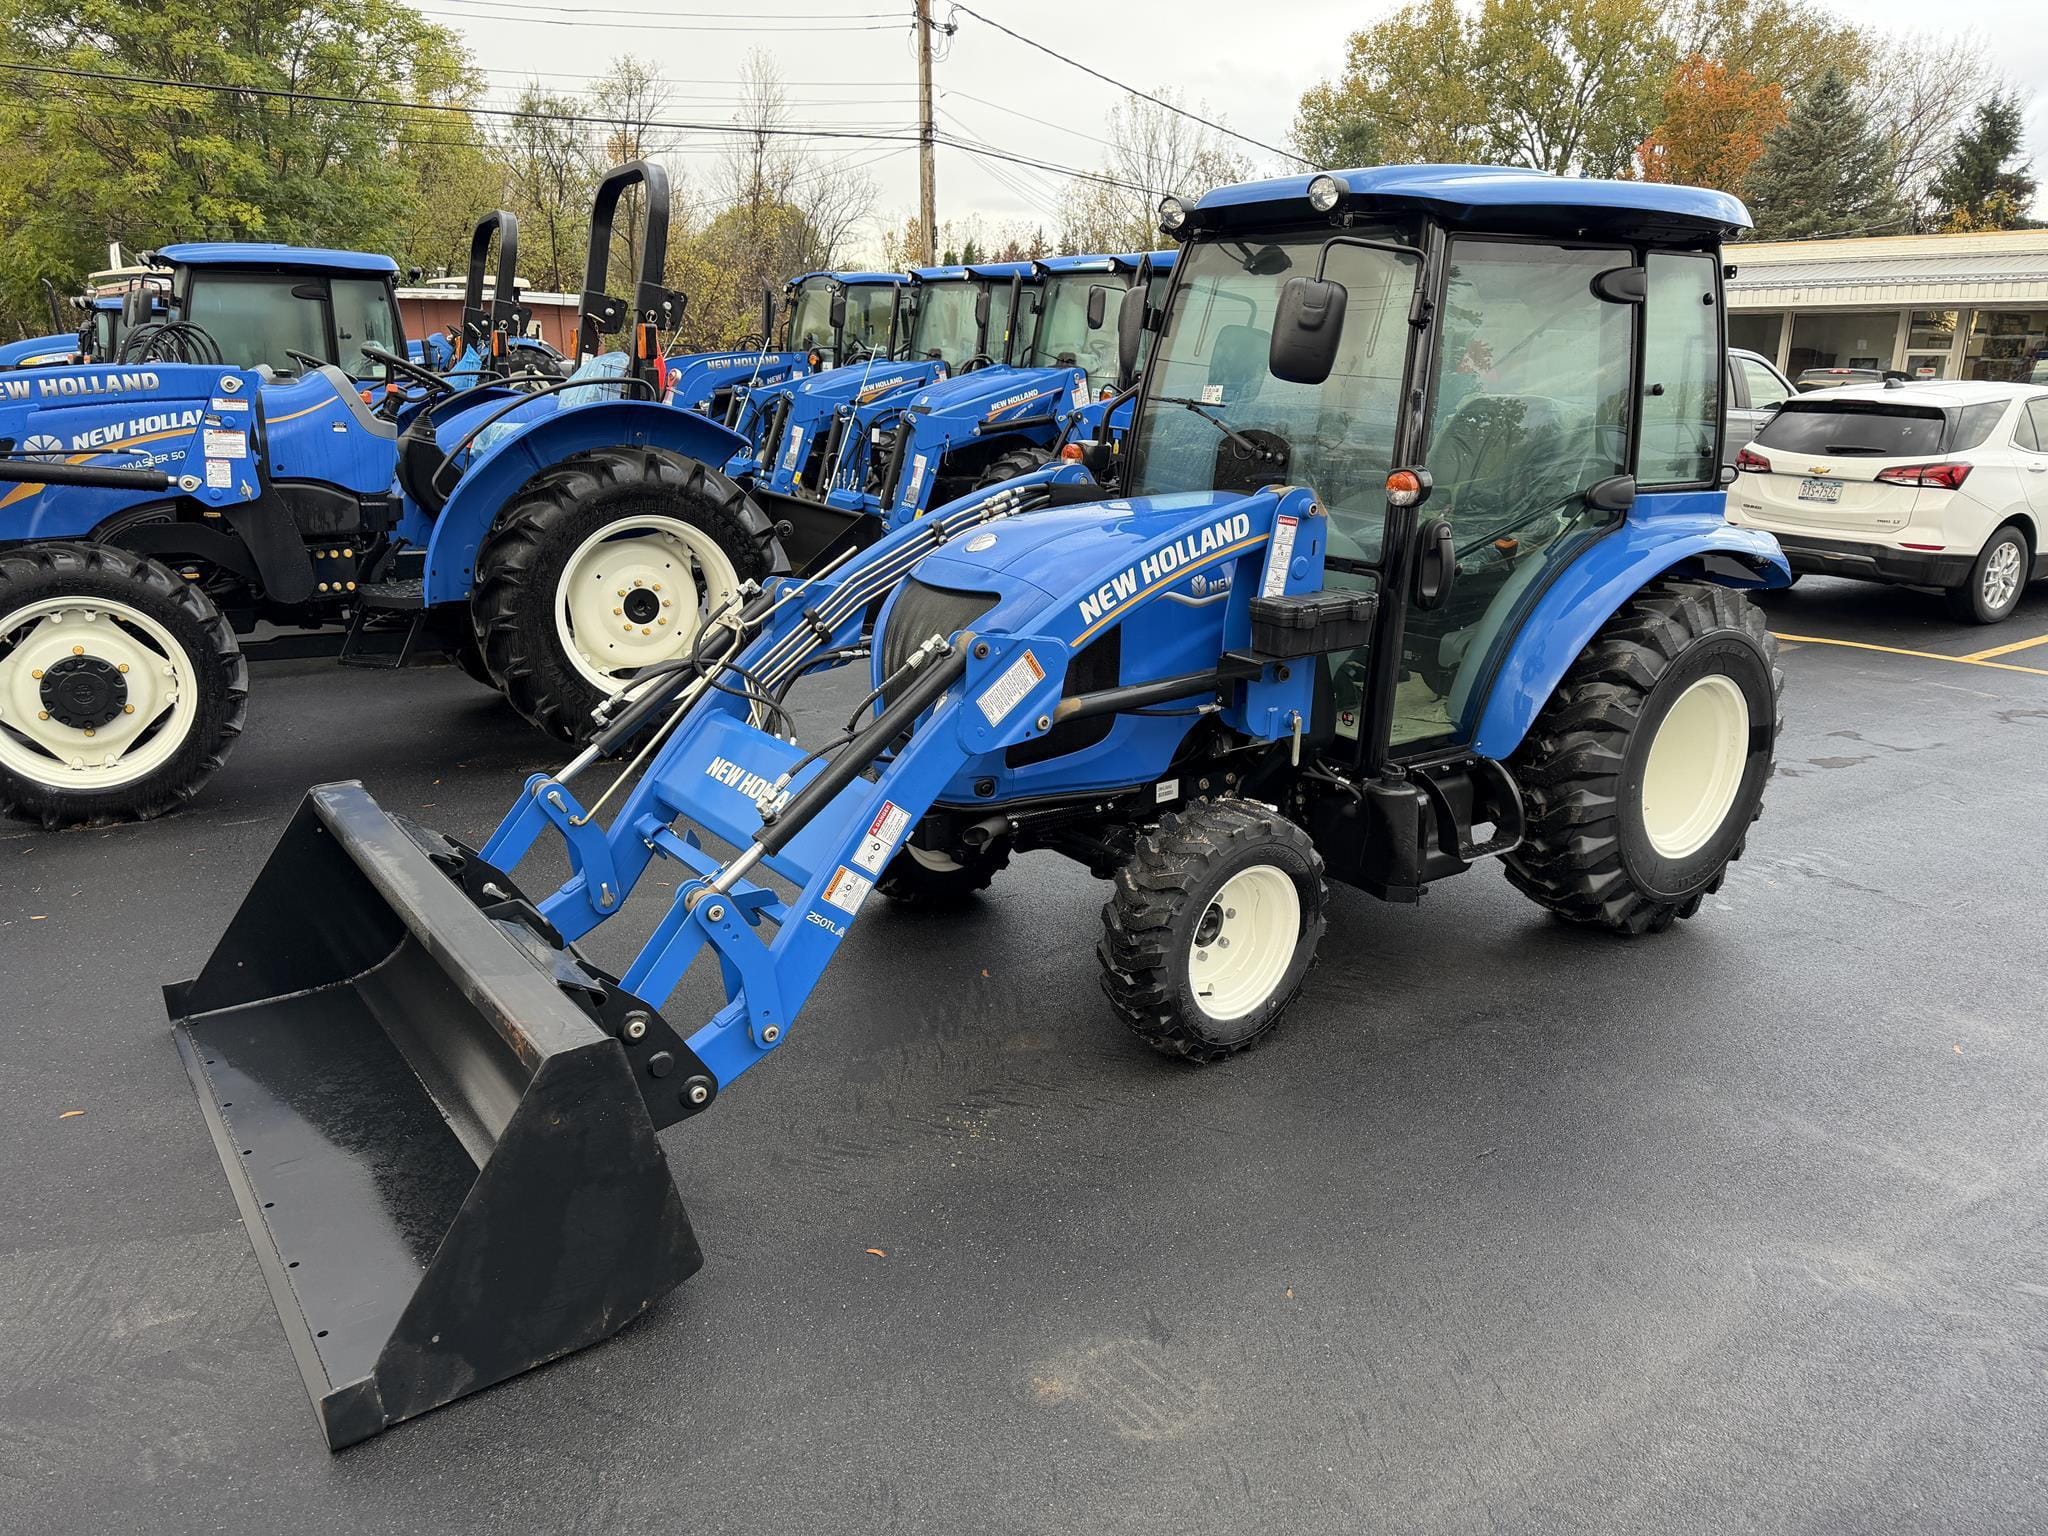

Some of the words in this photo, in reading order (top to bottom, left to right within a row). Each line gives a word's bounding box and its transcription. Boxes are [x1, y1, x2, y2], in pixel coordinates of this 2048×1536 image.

[706, 358, 731, 370] NEW
[38, 372, 160, 398] HOLLAND
[875, 376, 903, 388] HOLLAND
[990, 400, 1007, 411] NEW
[1007, 388, 1039, 405] HOLLAND
[72, 422, 125, 450] NEW
[171, 450, 186, 461] 50
[1078, 568, 1138, 625] NEW
[1140, 512, 1250, 584] HOLLAND
[705, 756, 746, 788] NEW
[876, 804, 891, 827] DANGER
